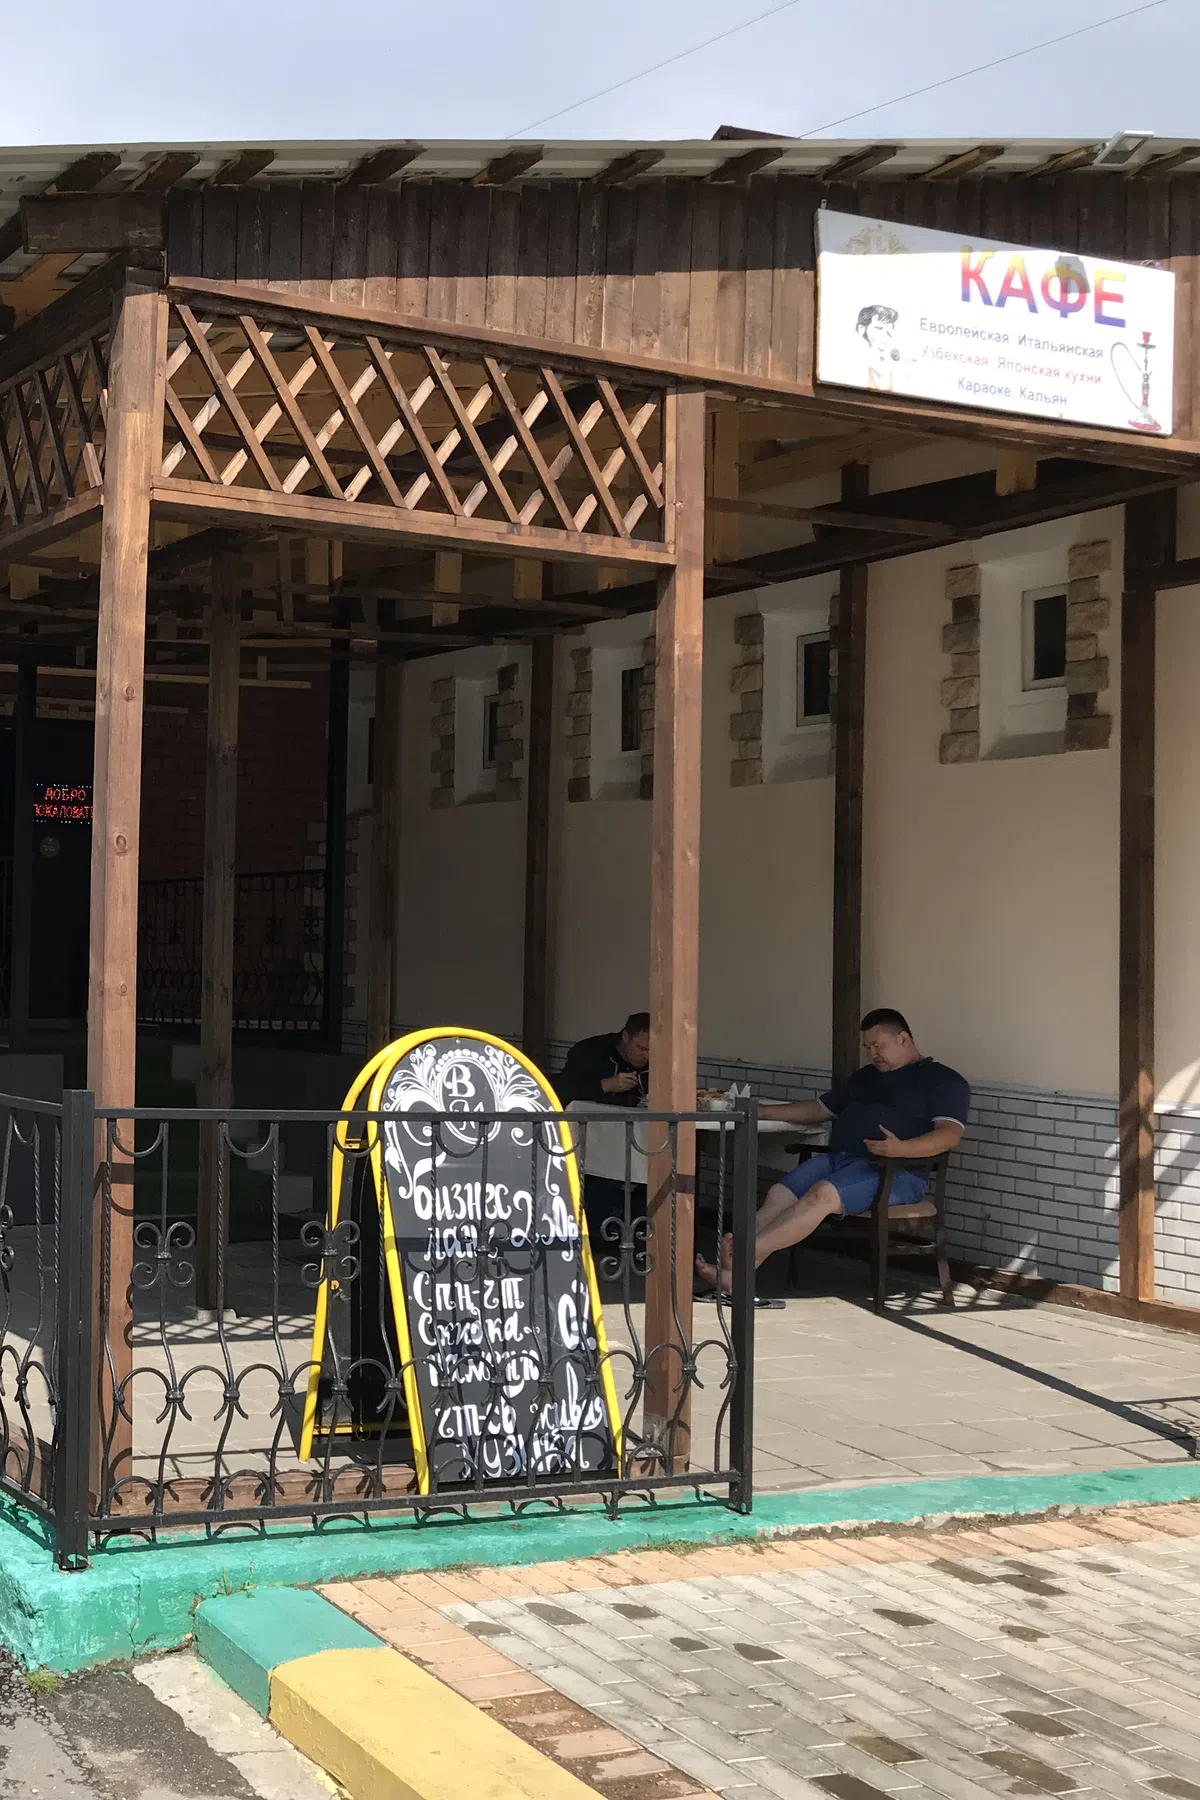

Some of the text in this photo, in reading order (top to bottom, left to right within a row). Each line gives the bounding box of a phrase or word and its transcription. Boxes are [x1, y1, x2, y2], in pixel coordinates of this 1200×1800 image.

[960, 245, 1127, 328] КАФЕ
[1017, 332, 1104, 359] Итальянская
[997, 356, 1060, 379] Японская
[1064, 370, 1103, 384] кухни
[1019, 385, 1068, 406] Кальян
[44, 787, 86, 802] ДОБРО
